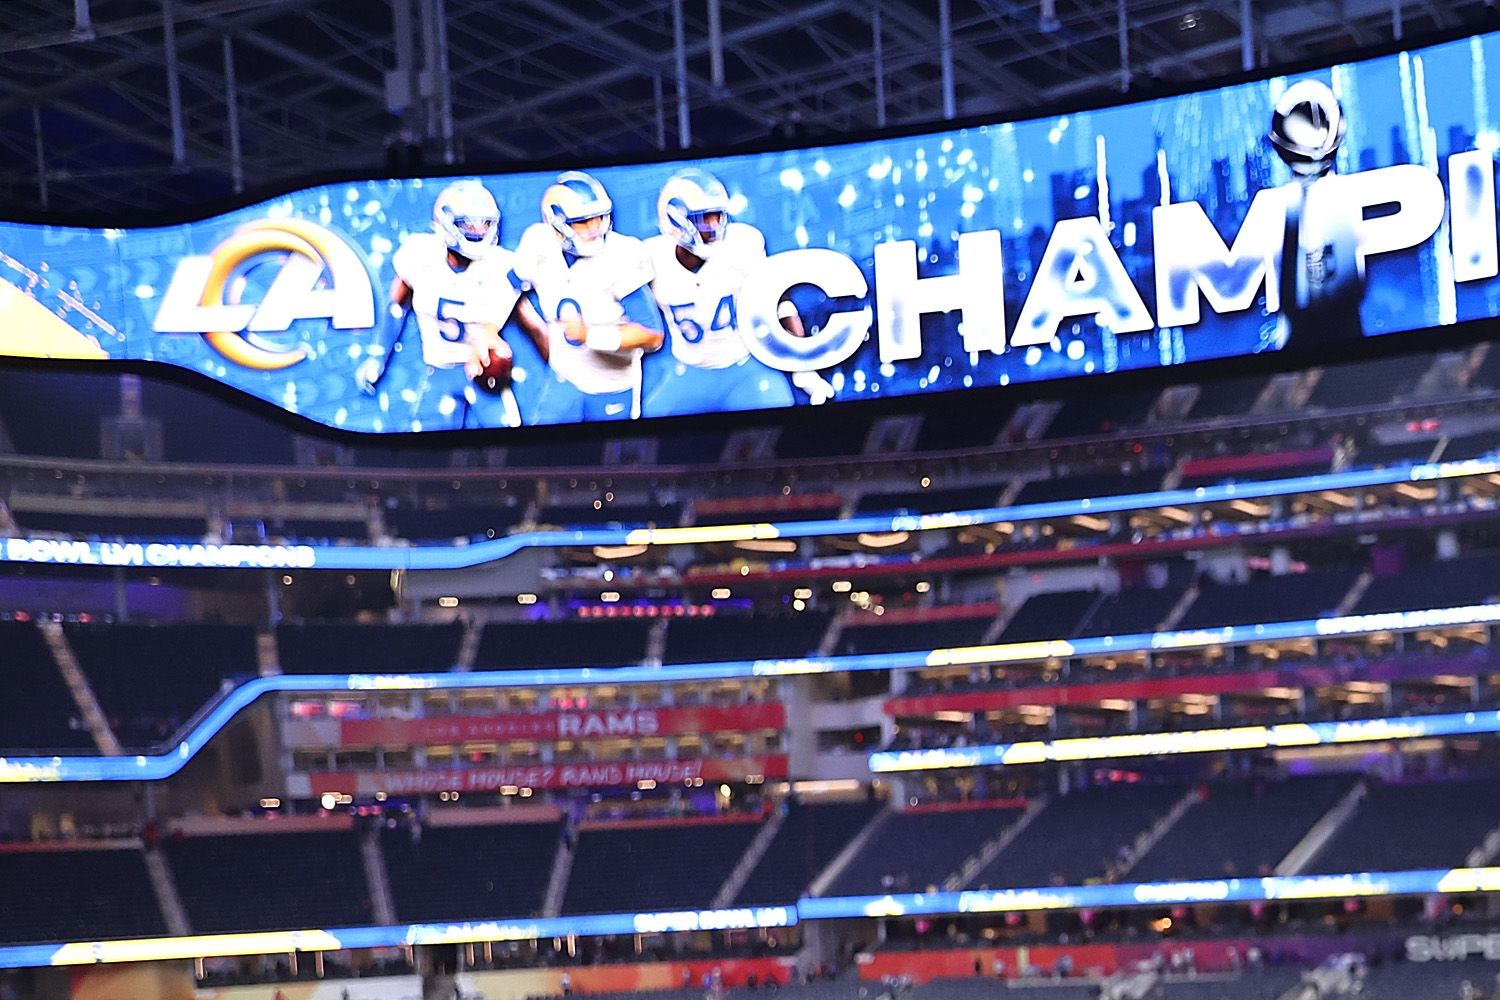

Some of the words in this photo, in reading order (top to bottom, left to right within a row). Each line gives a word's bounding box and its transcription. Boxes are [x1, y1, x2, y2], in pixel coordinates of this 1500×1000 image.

[152, 222, 376, 334] LA
[437, 297, 468, 342] 5
[669, 294, 739, 343] 54
[7, 538, 98, 565] BOWL
[145, 543, 316, 568] CHAMPIONS
[558, 711, 660, 737] RAMS
